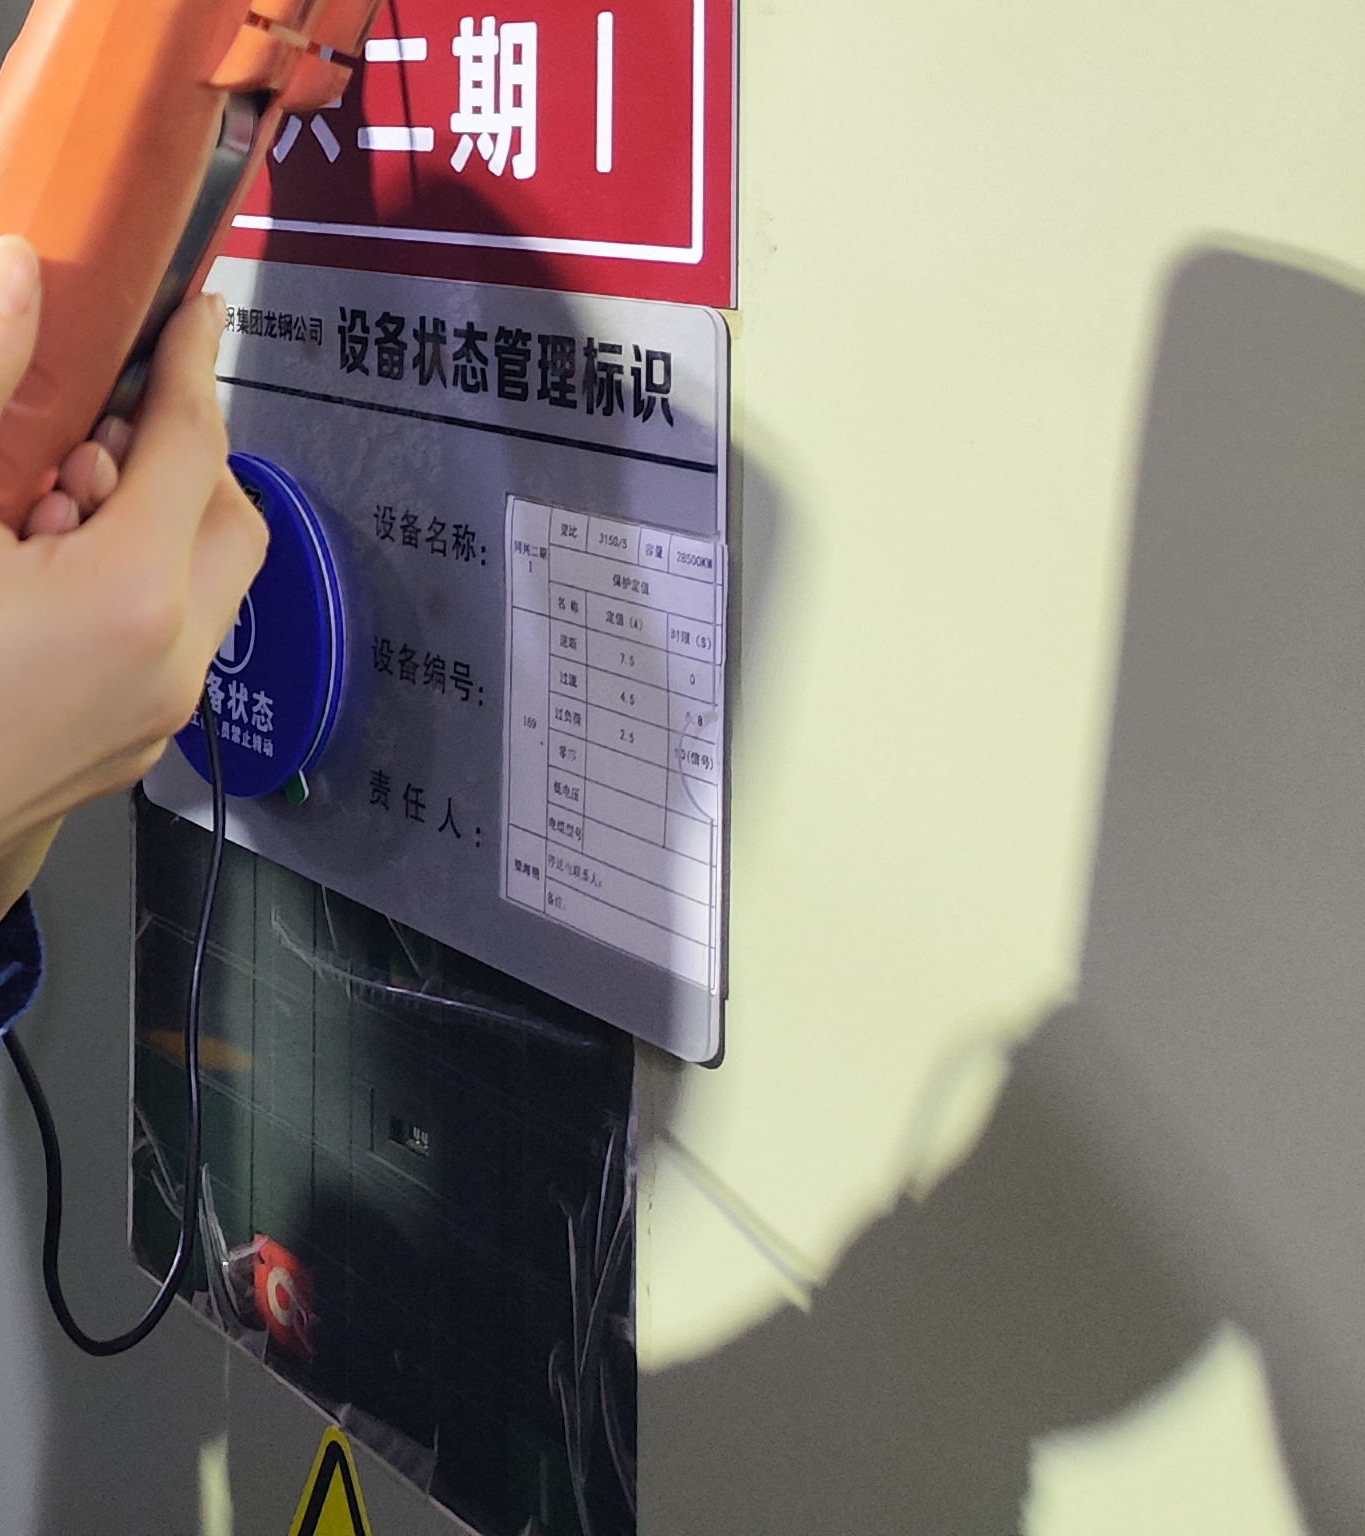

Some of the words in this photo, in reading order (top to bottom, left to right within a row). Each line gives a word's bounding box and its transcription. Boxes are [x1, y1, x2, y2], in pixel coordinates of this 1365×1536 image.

[338, 306, 674, 428] 设备状态管理标识
